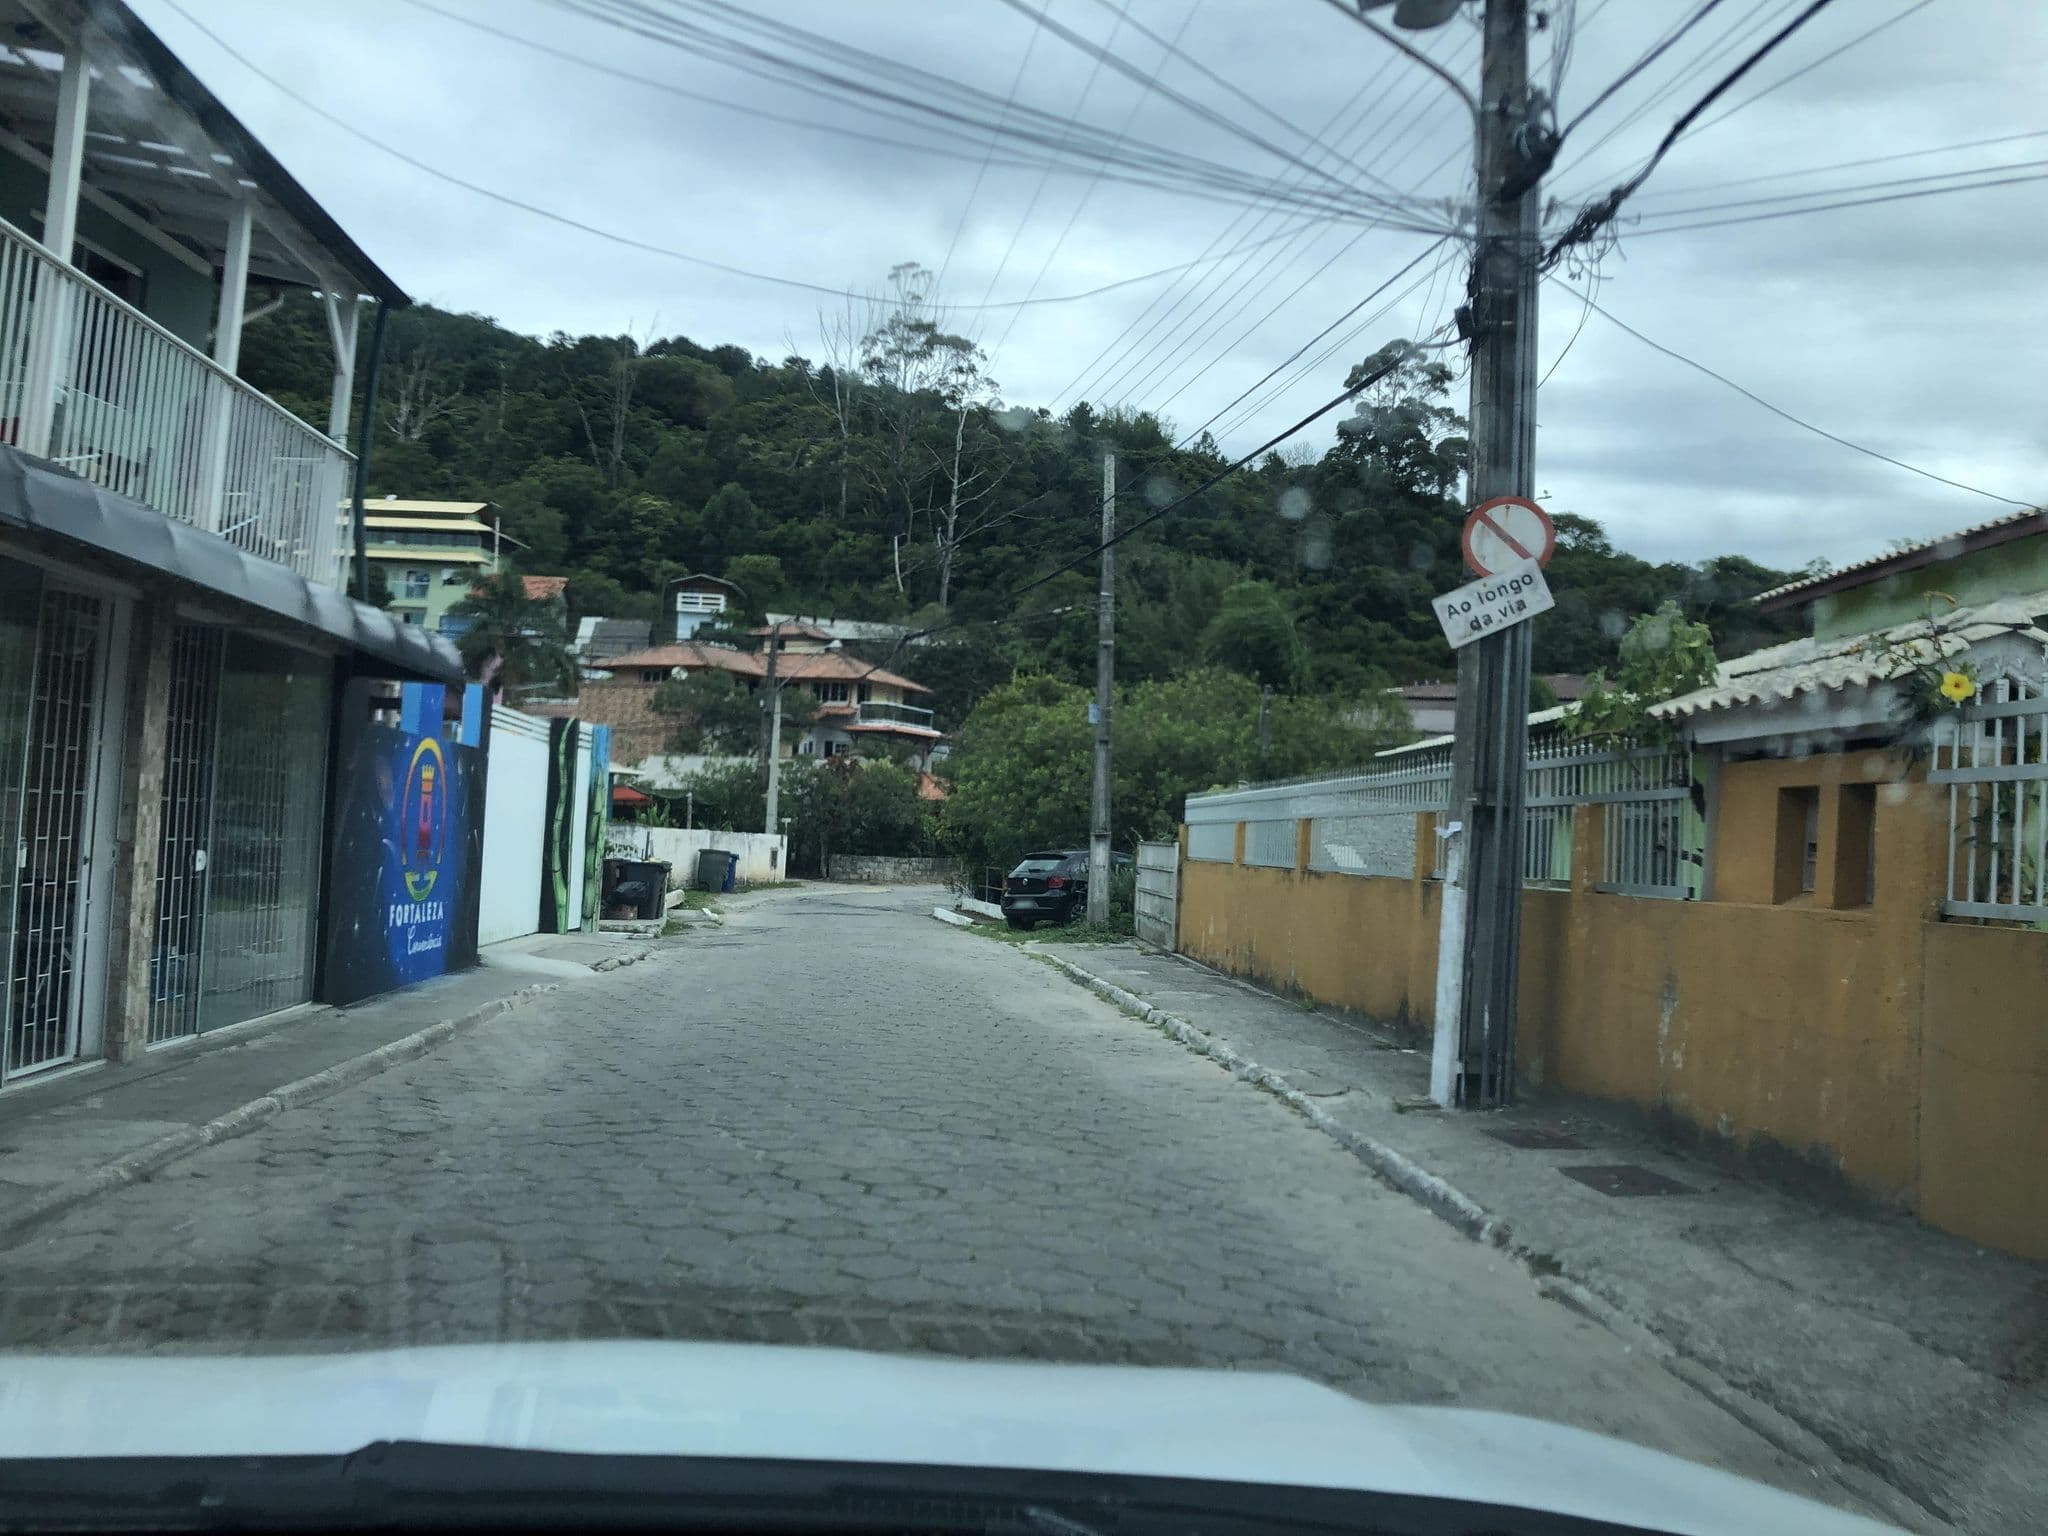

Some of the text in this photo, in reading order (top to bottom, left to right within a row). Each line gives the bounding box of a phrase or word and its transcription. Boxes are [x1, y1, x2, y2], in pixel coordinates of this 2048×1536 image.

[1447, 574, 1533, 619] Ao longo
[1470, 599, 1526, 631] da via
[389, 901, 443, 928] FORTALEZA
